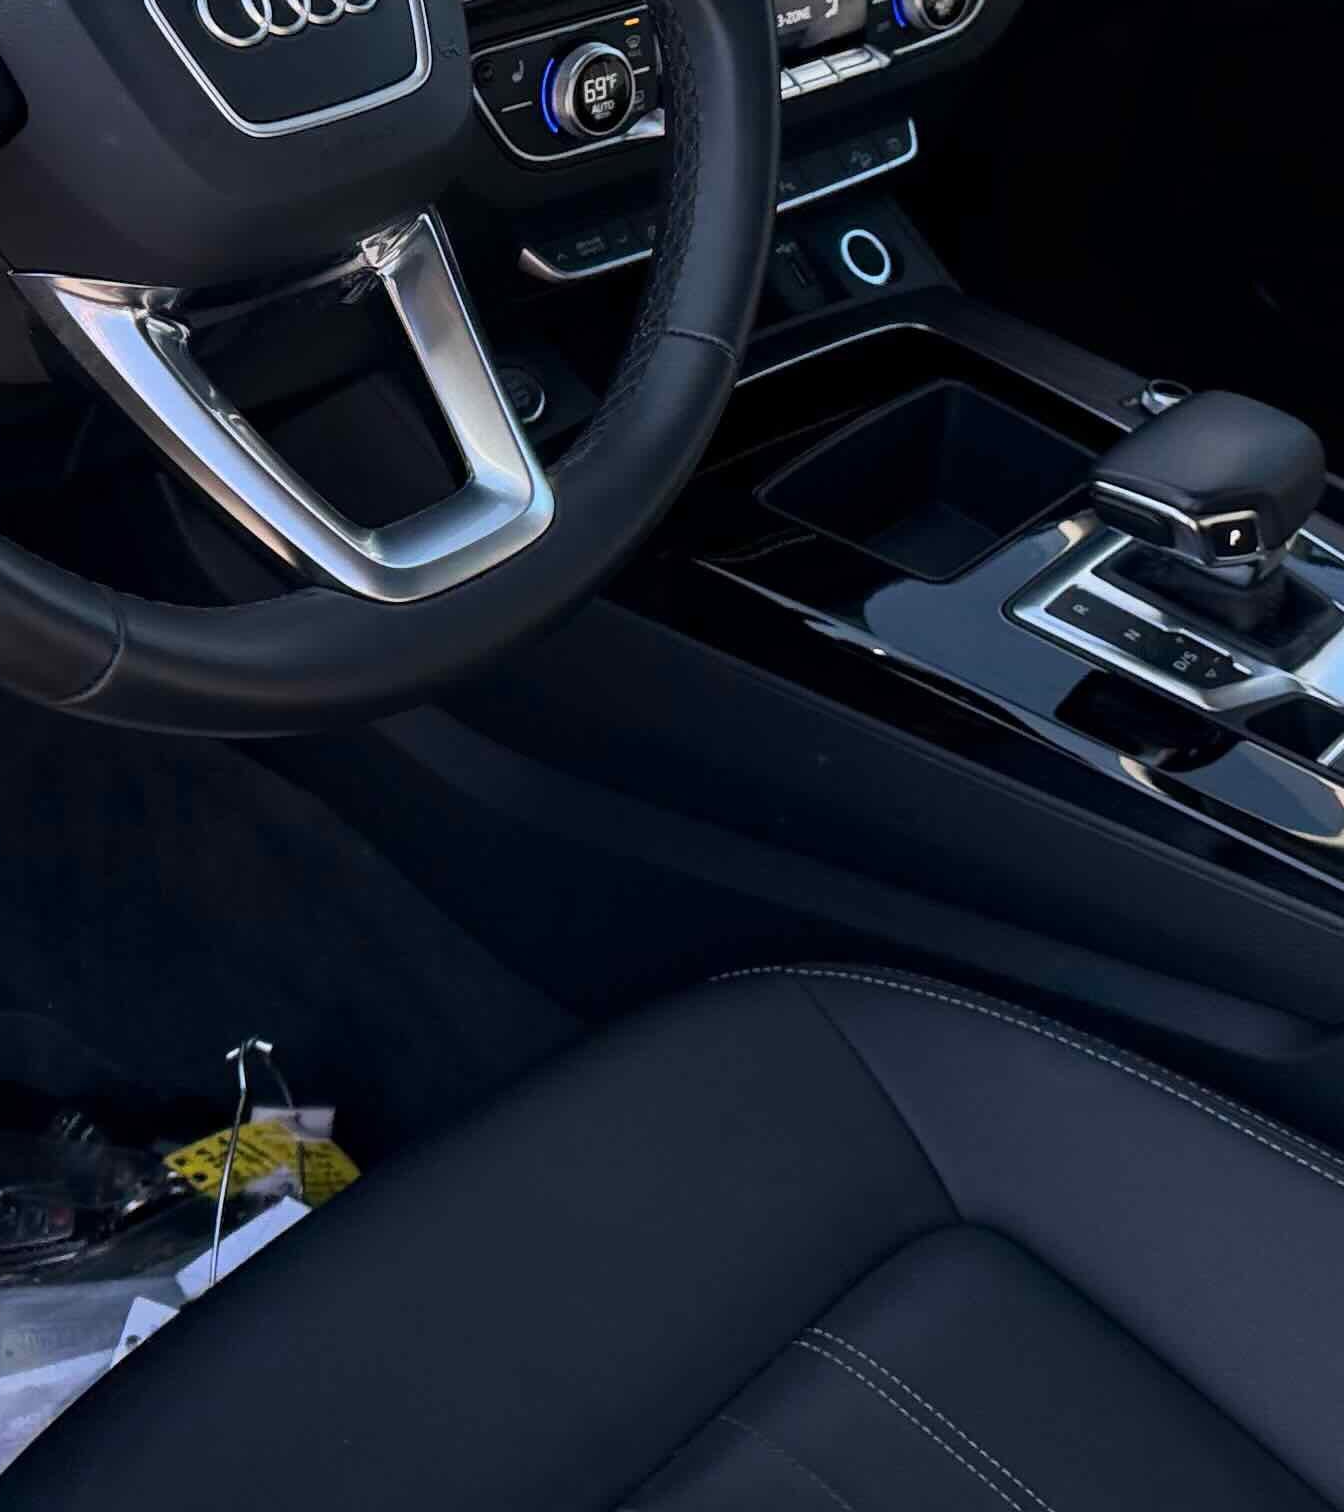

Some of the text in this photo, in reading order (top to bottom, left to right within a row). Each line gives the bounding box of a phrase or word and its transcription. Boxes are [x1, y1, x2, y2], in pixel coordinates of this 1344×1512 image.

[583, 72, 618, 105] 69°F
[591, 98, 616, 114] AUTO
[1229, 529, 1241, 547] P
[1071, 603, 1089, 617] R
[1122, 628, 1142, 642] N
[1172, 651, 1198, 672] D/S
